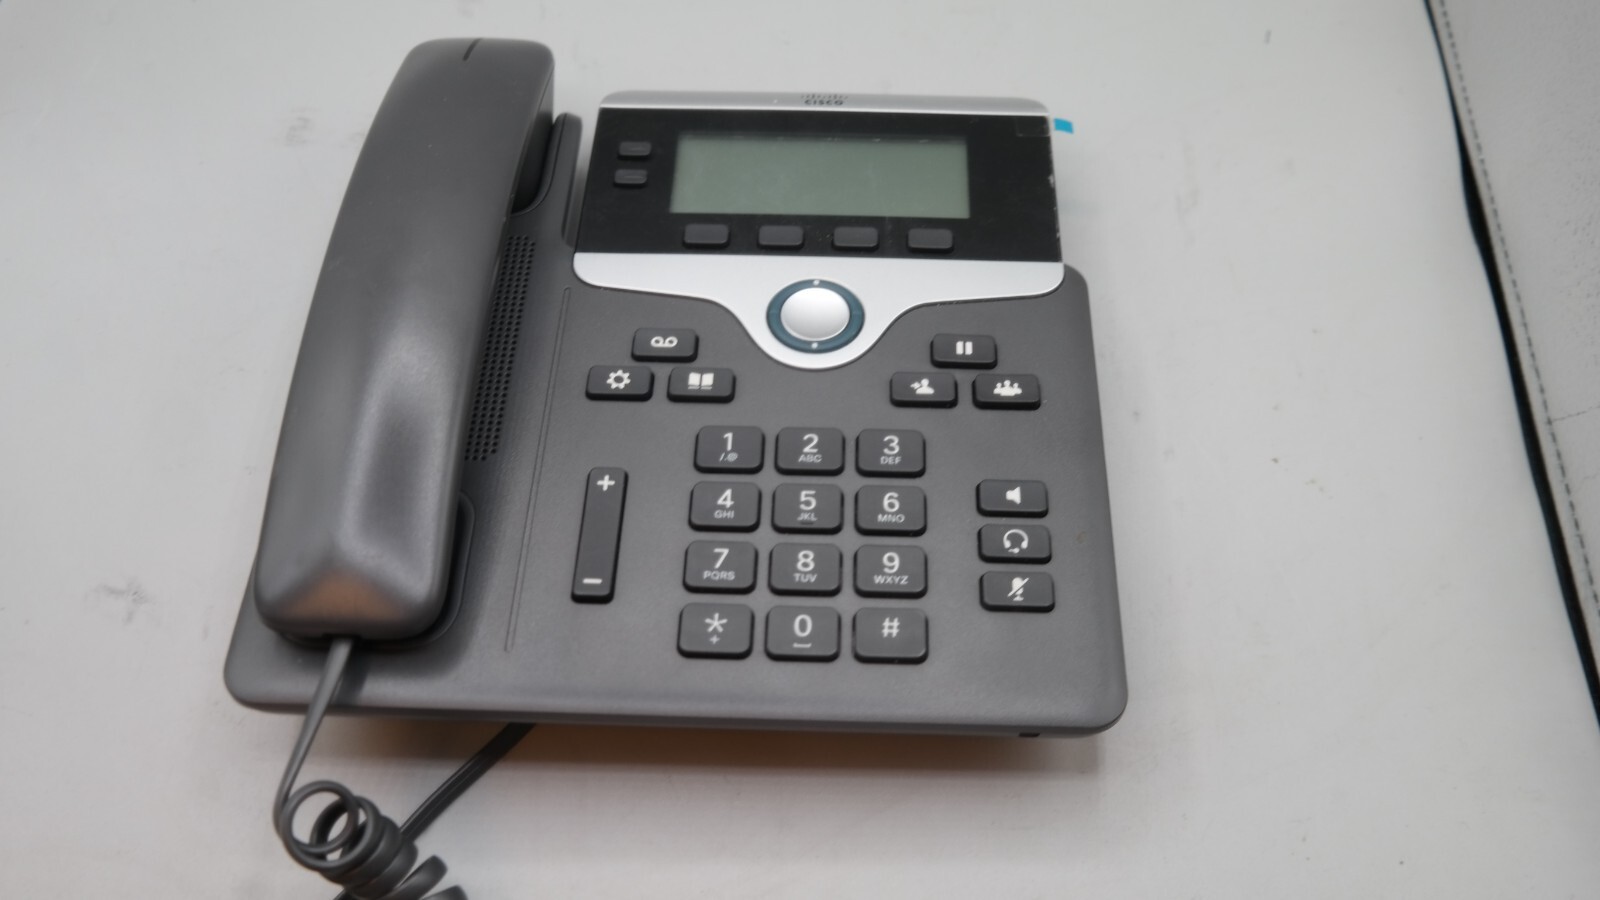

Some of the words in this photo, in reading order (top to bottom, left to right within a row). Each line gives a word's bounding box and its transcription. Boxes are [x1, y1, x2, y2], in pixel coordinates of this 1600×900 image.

[723, 432, 734, 452] 1
[802, 433, 819, 453] 2
[883, 435, 900, 455] 3
[798, 454, 822, 463] ABC
[880, 456, 902, 465] DEF
[717, 488, 734, 508] 4
[799, 490, 817, 511] 5
[883, 492, 900, 513] 6
[714, 510, 734, 519] GHI
[797, 513, 817, 522] JKL
[877, 513, 905, 523] MNO
[713, 548, 729, 570] 7
[797, 550, 815, 572] 8
[882, 551, 900, 573] 9
[703, 570, 736, 581] PQRS
[794, 572, 818, 583] TUV
[874, 574, 908, 584] WXYZ
[794, 613, 812, 637] 0
[882, 617, 900, 637] #
